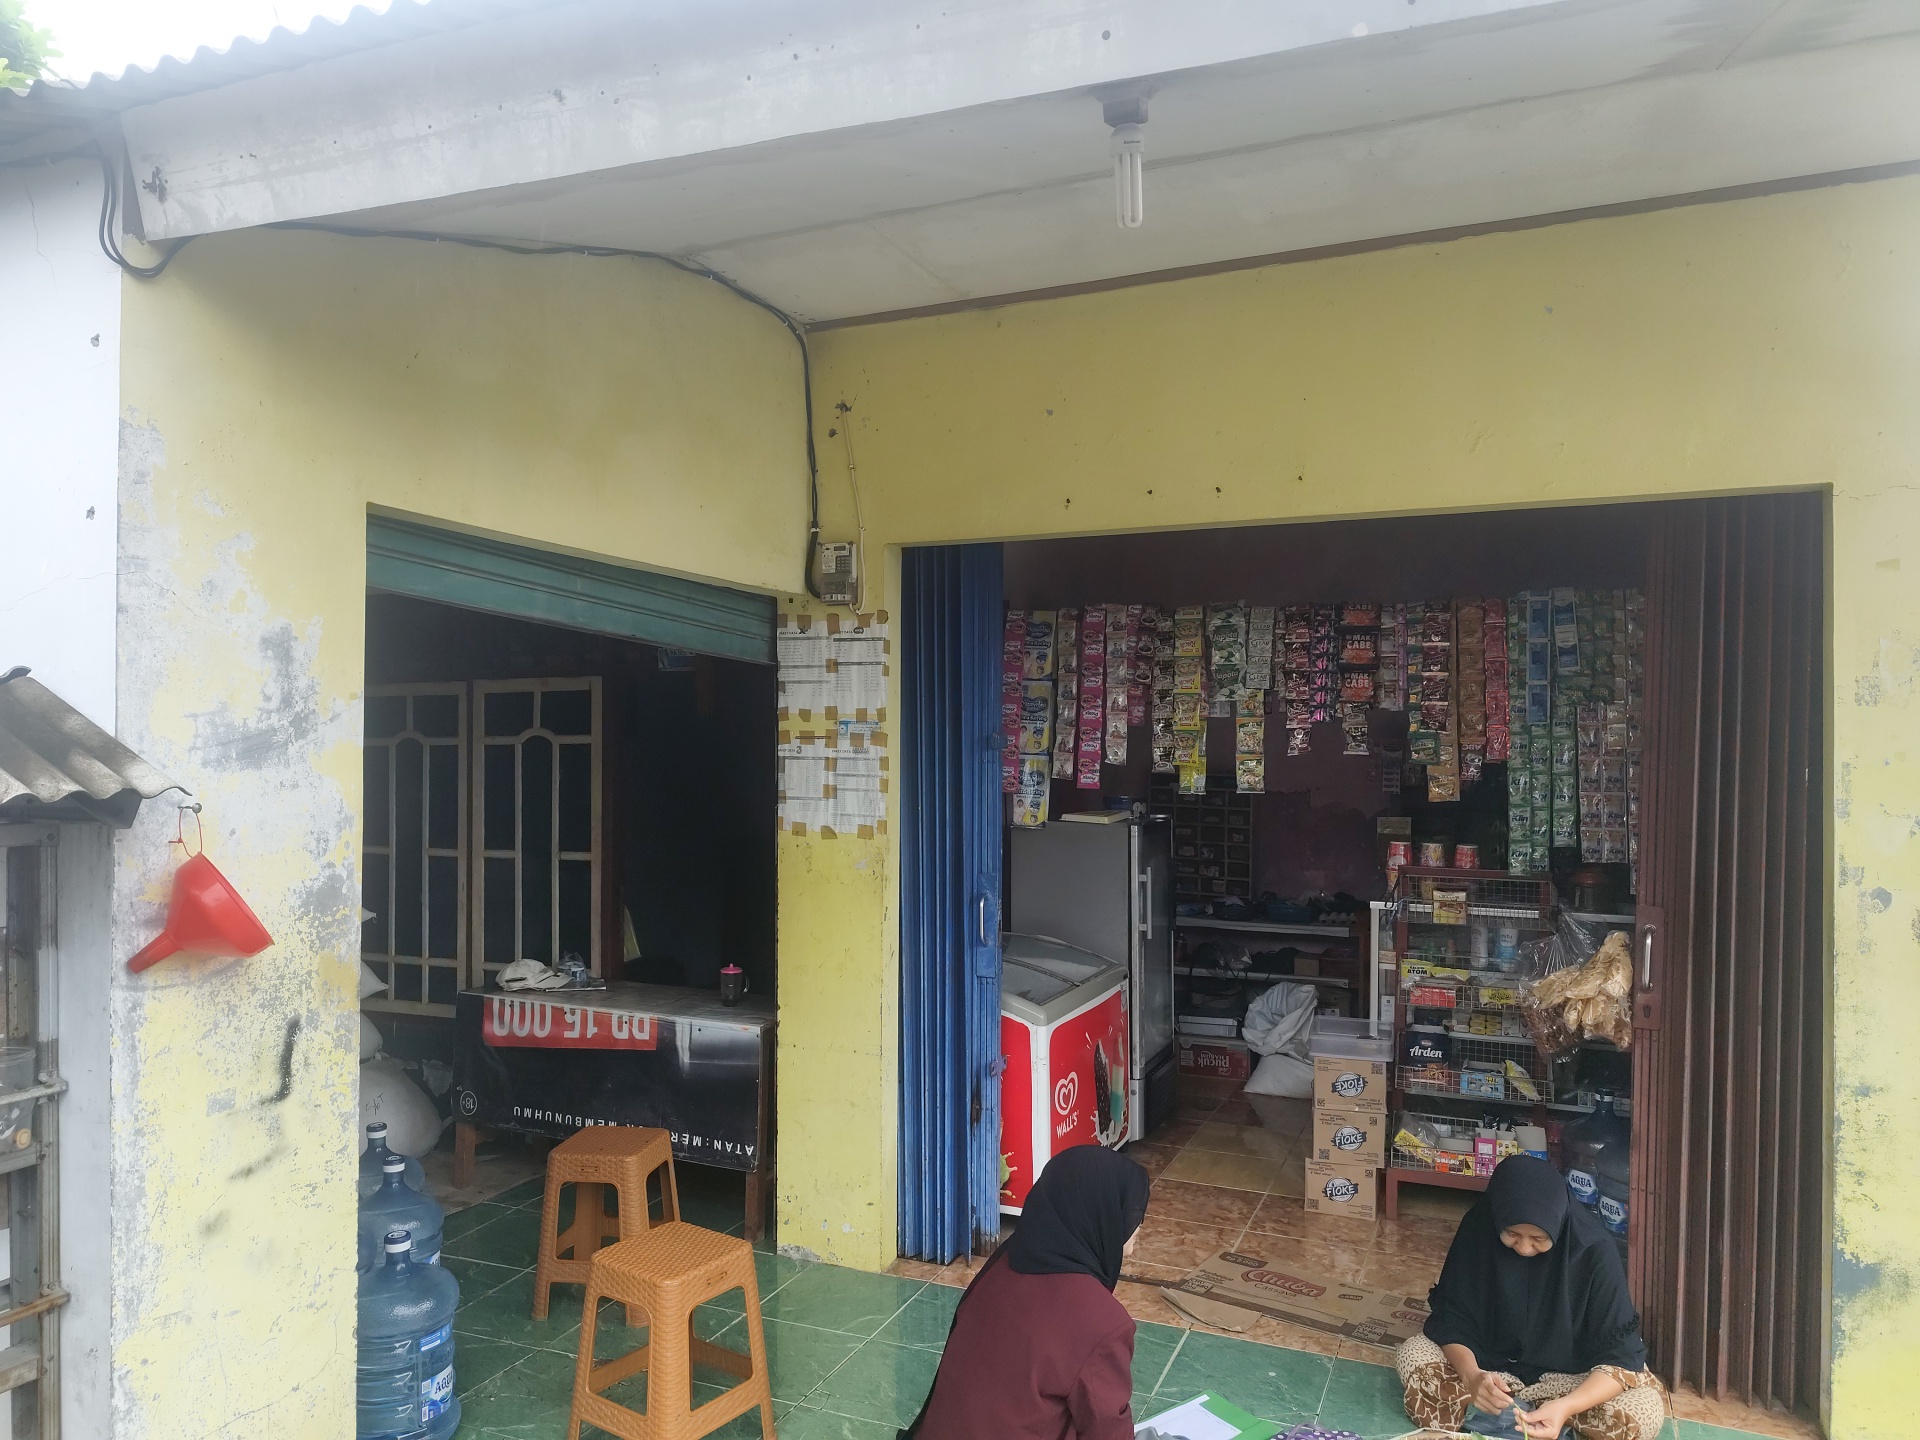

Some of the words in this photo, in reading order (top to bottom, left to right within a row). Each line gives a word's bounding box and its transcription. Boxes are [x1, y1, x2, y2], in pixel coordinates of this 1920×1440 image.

[1347, 641, 1371, 649] CABE
[1345, 680, 1369, 688] CABE
[1409, 1046, 1443, 1059] Arden
[1198, 1056, 1230, 1068] Pucuk
[1335, 1077, 1364, 1091] FIOKE
[1056, 1111, 1078, 1139] WALL'S
[1335, 1133, 1363, 1147] FIOKE
[1570, 1174, 1592, 1188] AQUA
[1326, 1184, 1356, 1197] FIOKE
[1601, 1200, 1621, 1217] AQUA
[1247, 1269, 1320, 1297] Chuba
[1254, 1282, 1298, 1298] Cassava
